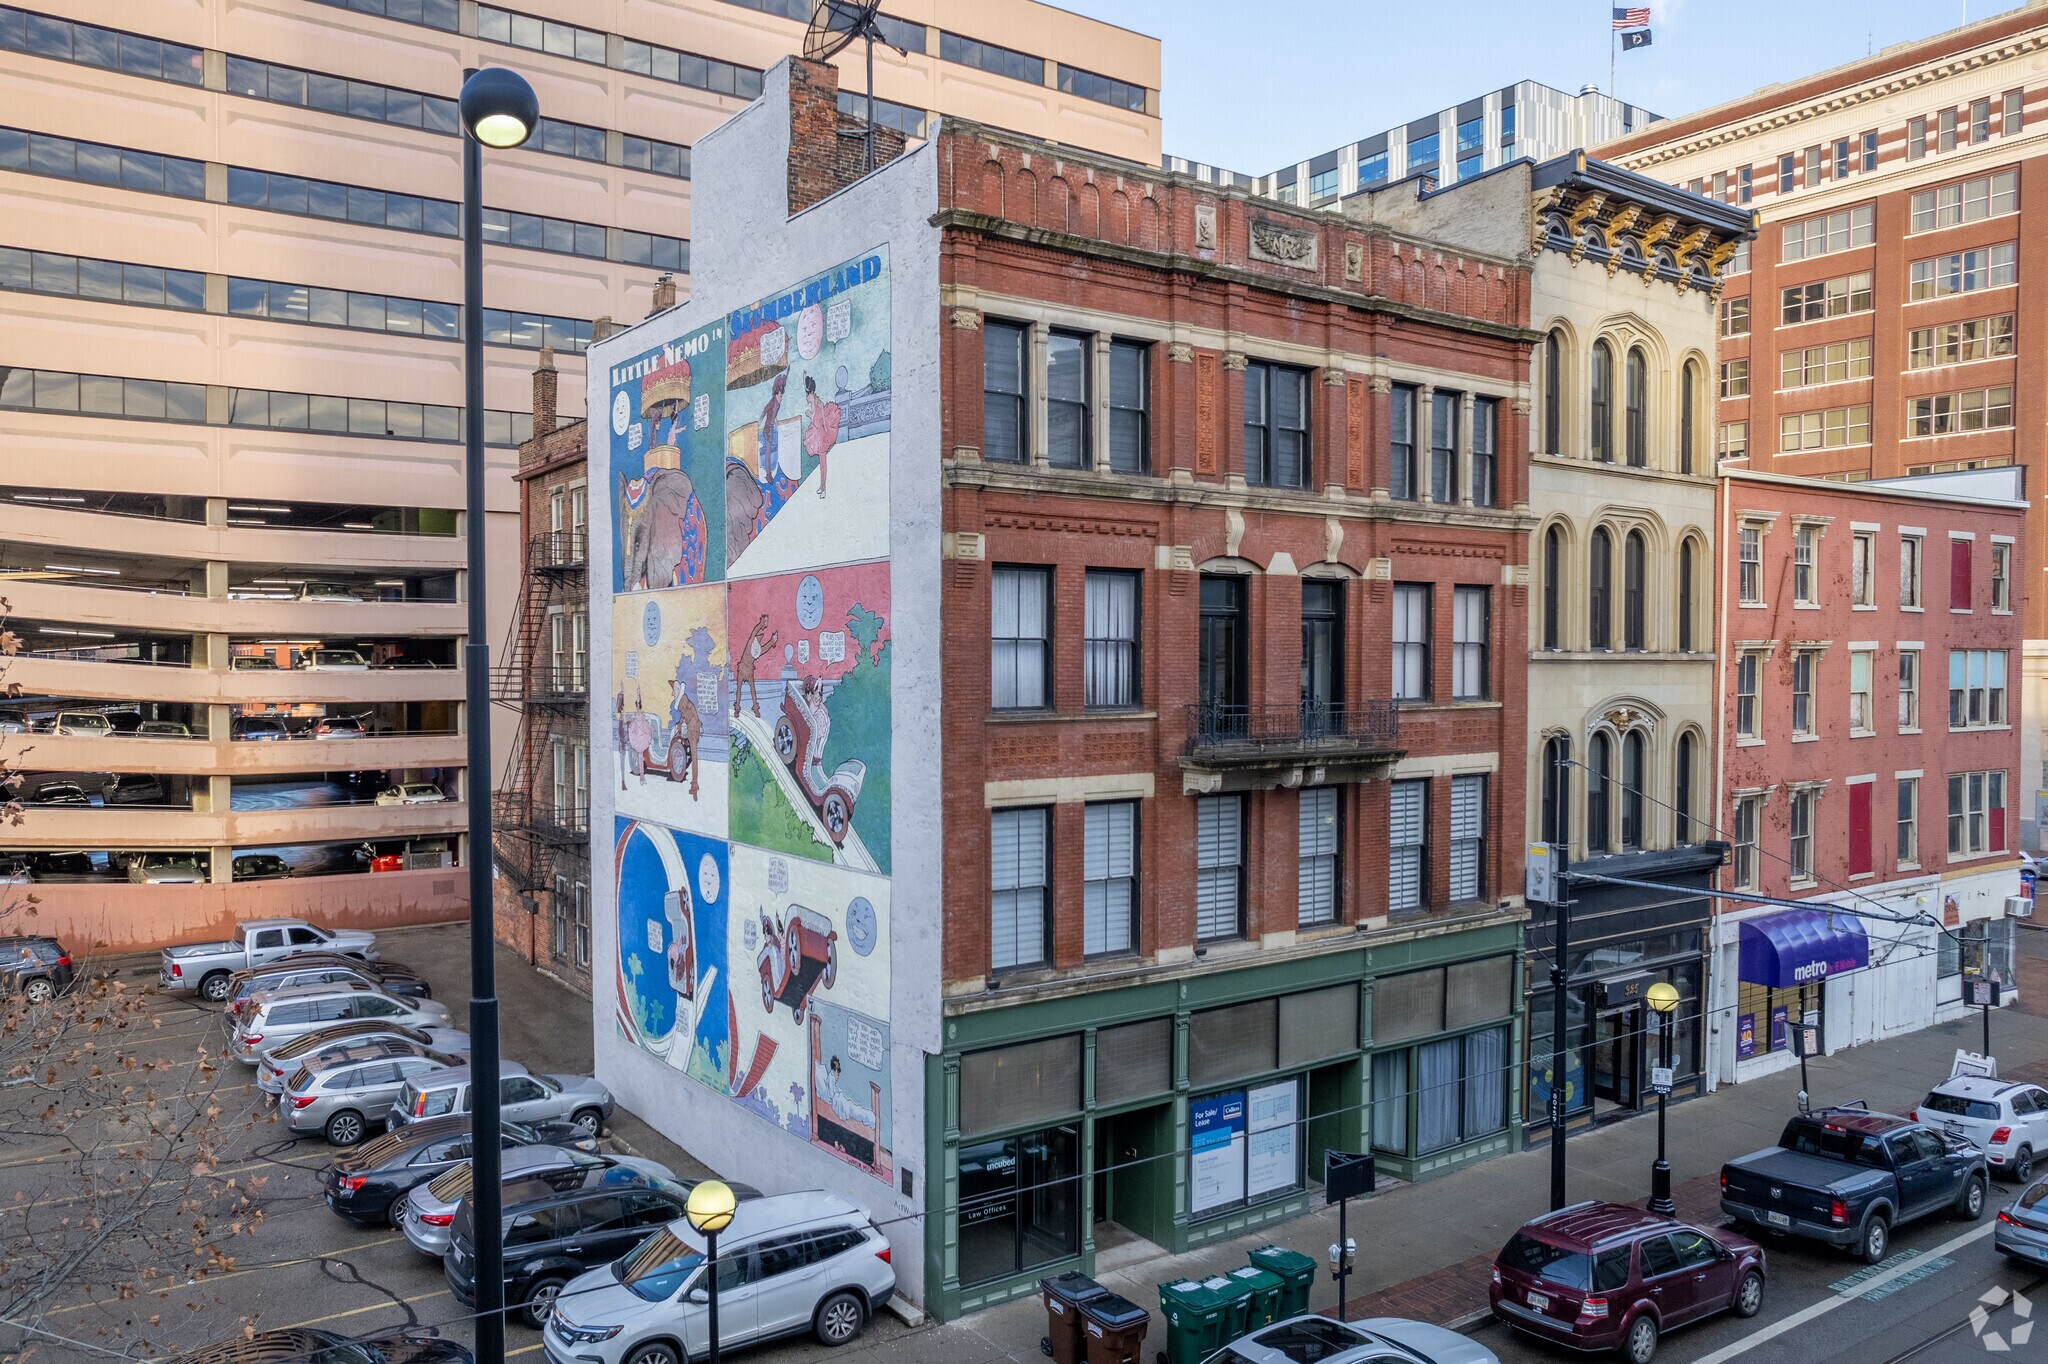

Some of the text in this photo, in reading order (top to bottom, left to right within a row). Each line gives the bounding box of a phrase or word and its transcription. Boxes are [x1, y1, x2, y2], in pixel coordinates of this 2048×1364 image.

[730, 255, 881, 341] SLUMBERLAND
[612, 327, 723, 387] LITTLE NEMO IN
[1794, 960, 1827, 981] metro
[1195, 1108, 1218, 1120] For Sale/
[1195, 1118, 1210, 1127] Lease
[968, 1210, 981, 1219] Law
[983, 1205, 1007, 1215] Offices
